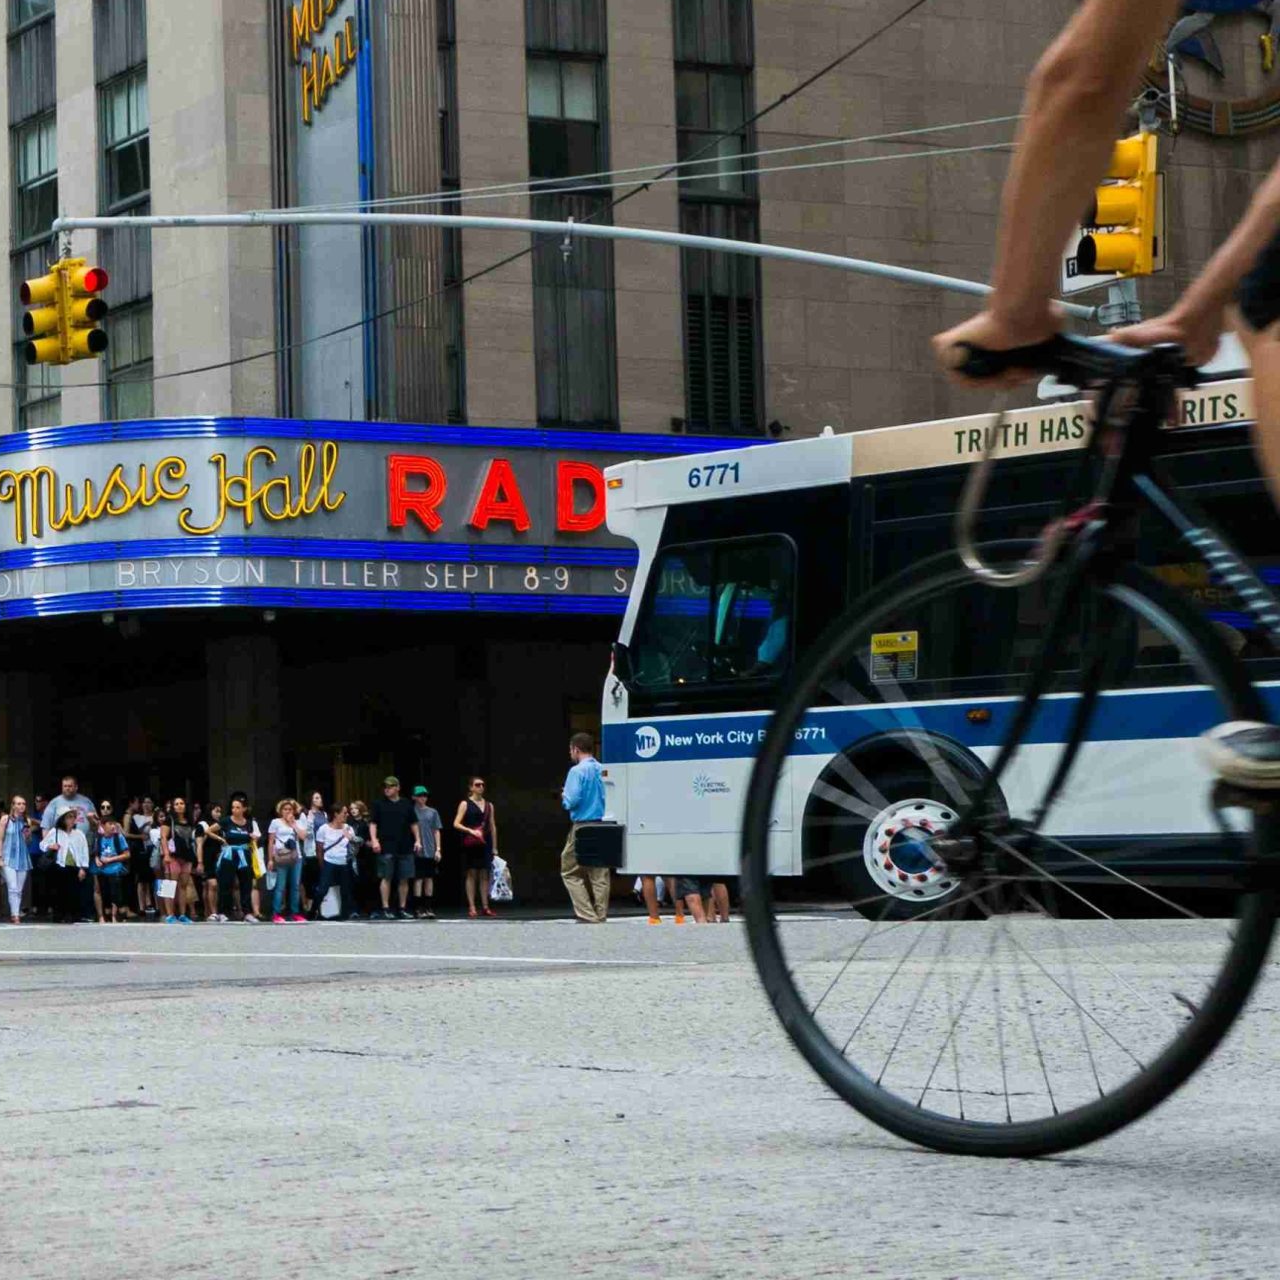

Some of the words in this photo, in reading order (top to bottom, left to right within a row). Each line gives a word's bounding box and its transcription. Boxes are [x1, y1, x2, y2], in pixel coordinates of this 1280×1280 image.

[302, 17, 357, 123] HALL
[954, 422, 1028, 454] TRUTH
[1039, 414, 1084, 444] HAS
[1182, 393, 1244, 424] RITS.
[178, 441, 347, 536] Hall
[387, 453, 607, 533] RAD
[687, 461, 740, 489] 6771
[118, 558, 265, 587] BRYSON
[290, 559, 400, 587] TILLER
[424, 563, 499, 590] SEPT
[523, 567, 569, 591] 8-9
[665, 734, 693, 747] New
[695, 731, 724, 746] York
[727, 729, 754, 744] City
[795, 727, 826, 740] 6771
